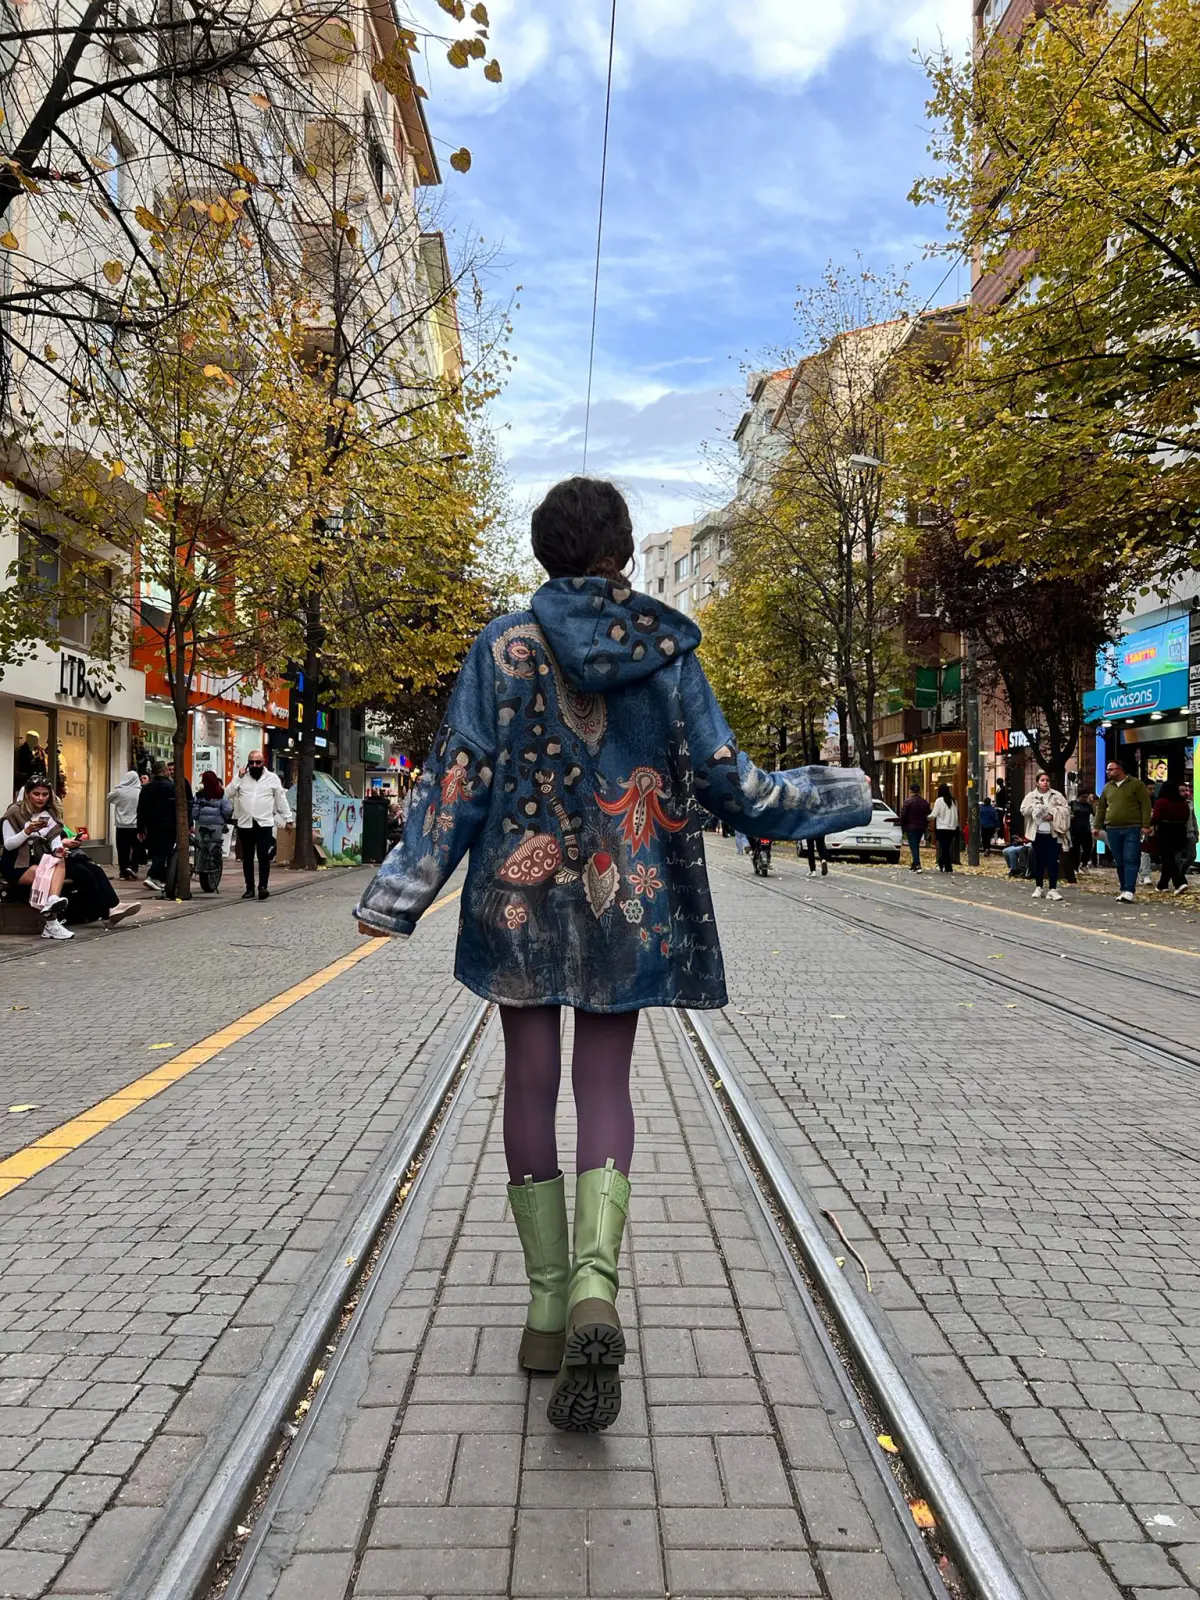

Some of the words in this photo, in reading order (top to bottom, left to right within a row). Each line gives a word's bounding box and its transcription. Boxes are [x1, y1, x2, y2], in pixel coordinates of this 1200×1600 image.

[60, 652, 86, 698] LTB
[1110, 688, 1153, 709] watsons
[65, 720, 85, 737] LTB
[994, 728, 1009, 753] IN
